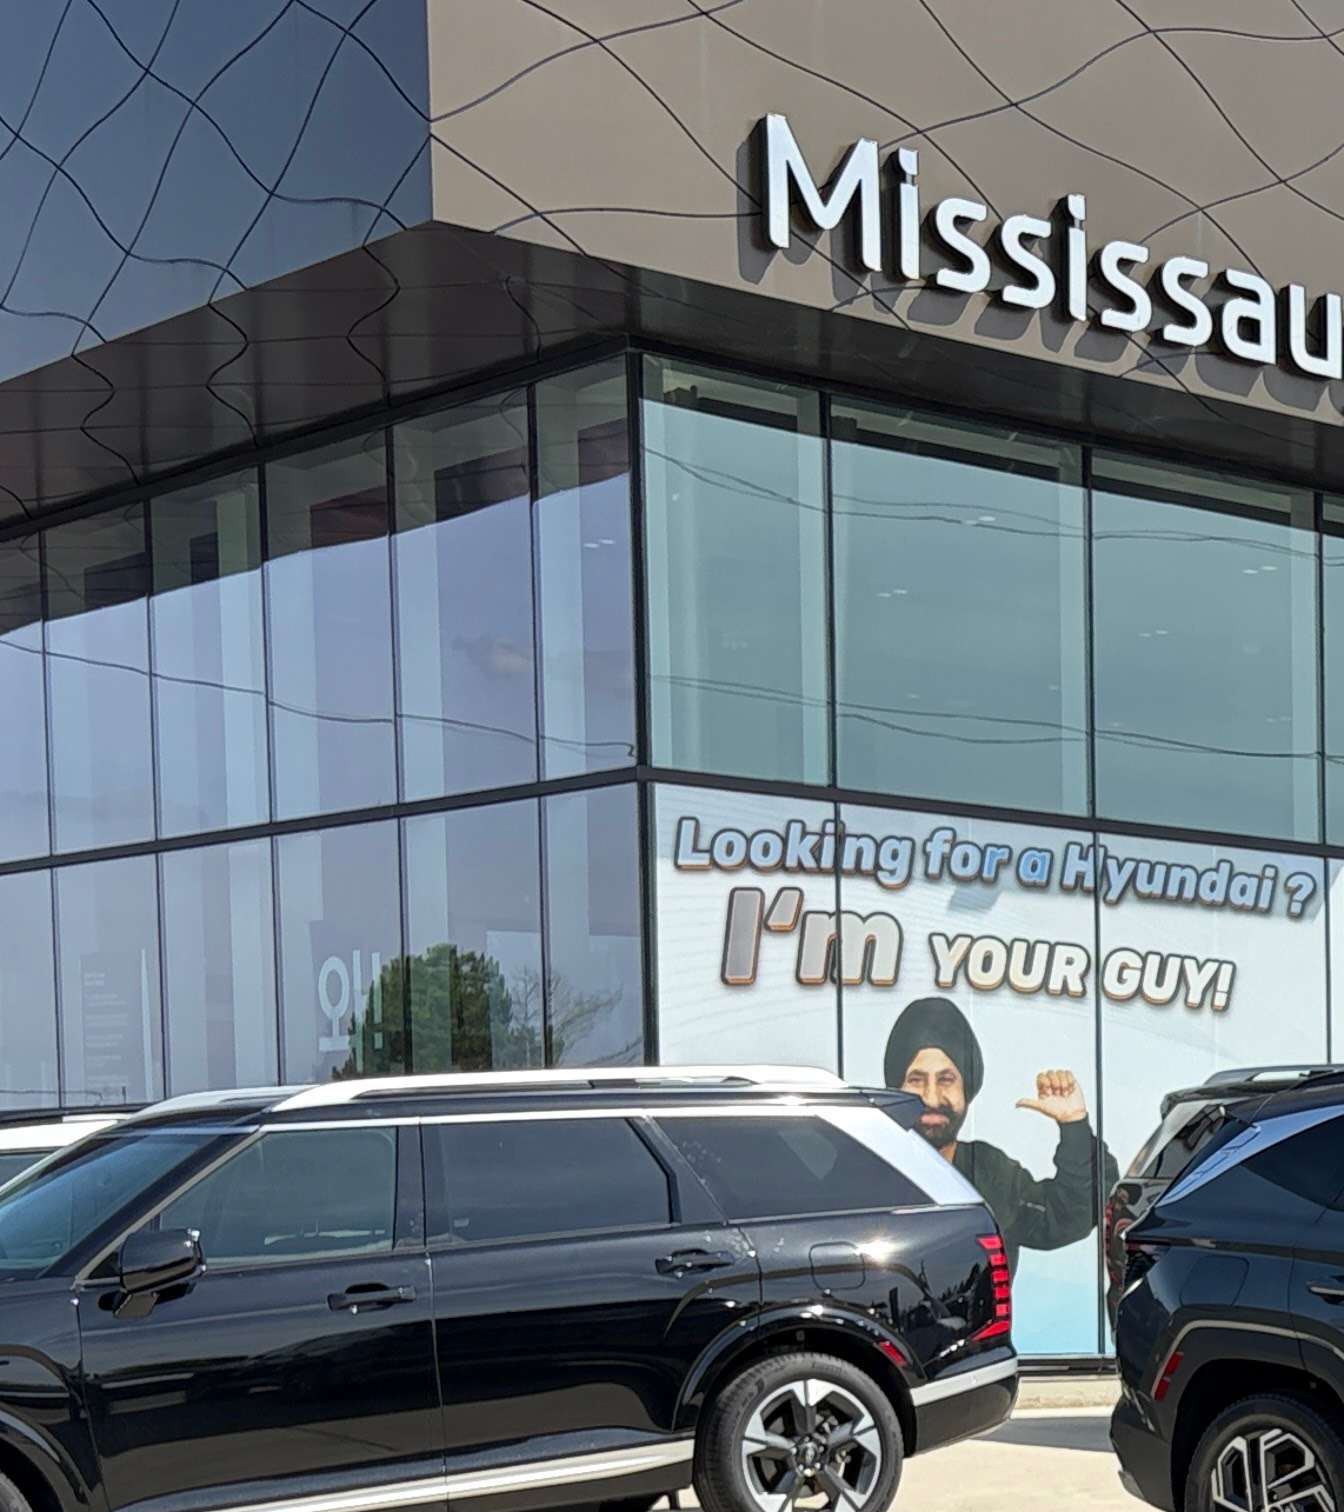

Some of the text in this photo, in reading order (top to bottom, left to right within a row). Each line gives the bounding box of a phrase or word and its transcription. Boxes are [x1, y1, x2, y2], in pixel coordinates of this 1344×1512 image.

[674, 816, 916, 889] Looking
[922, 826, 1014, 884] for
[1014, 847, 1054, 889] a
[1062, 841, 1279, 913] Hyundai
[719, 886, 1238, 1011] I'm YOUR GUY!
